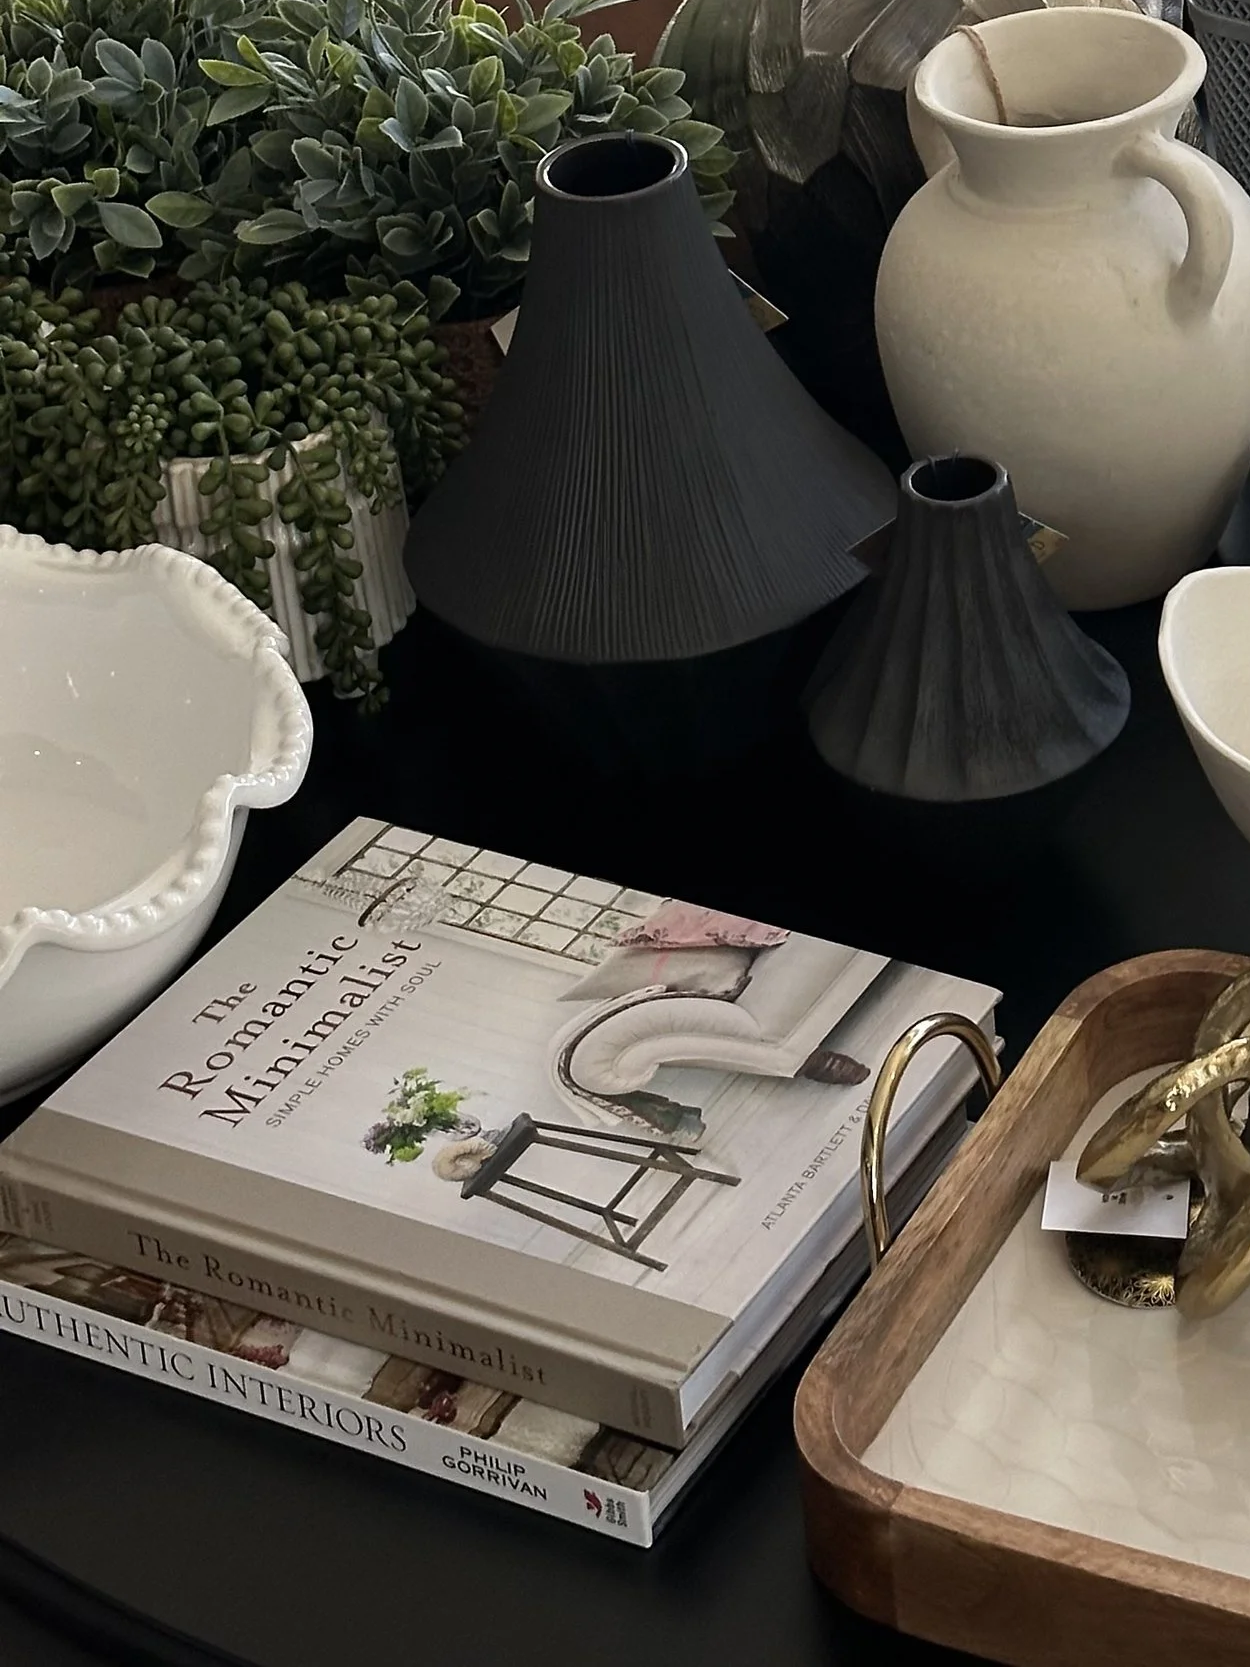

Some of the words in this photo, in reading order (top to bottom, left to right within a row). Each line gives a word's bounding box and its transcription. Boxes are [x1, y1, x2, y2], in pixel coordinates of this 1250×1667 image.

[158, 935, 358, 1100] Romantic
[191, 981, 258, 1024] The
[199, 939, 422, 1128] Minimalist
[265, 1077, 321, 1128] SIMPLE
[316, 1029, 370, 1078] HOMES
[365, 995, 405, 1030] WITH
[400, 959, 442, 994] SOUL
[761, 1181, 806, 1230] ATLANTA
[802, 1124, 852, 1179] BARTLETT
[848, 1114, 861, 1124] &
[0, 1294, 195, 1382] UTHENTIC
[208, 1363, 407, 1453] INTERIORS
[128, 1230, 190, 1270] The
[203, 1255, 355, 1322] Romantic
[366, 1306, 548, 1386] Minimalist
[442, 1455, 548, 1501] GORRIVAN
[460, 1446, 526, 1477] PHILIP
